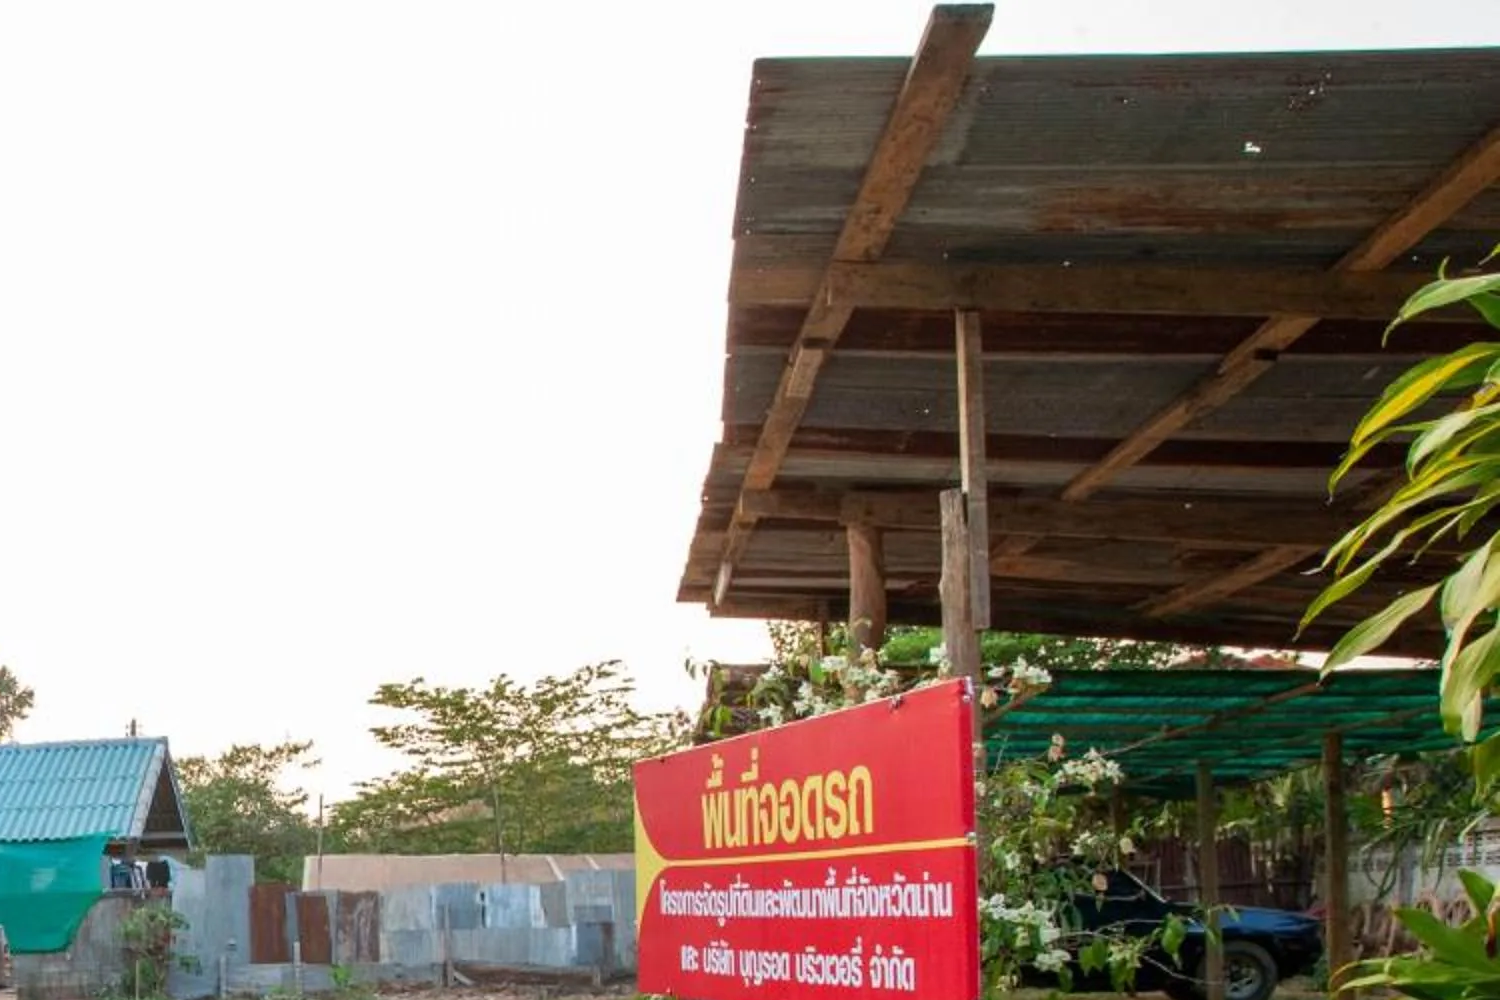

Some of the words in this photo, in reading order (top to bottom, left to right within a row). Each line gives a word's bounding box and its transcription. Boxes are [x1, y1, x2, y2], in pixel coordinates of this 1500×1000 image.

[702, 748, 873, 848] พื้นที่จอดรถ
[739, 949, 790, 987] บุญรอด
[870, 944, 915, 991] จำกัด
